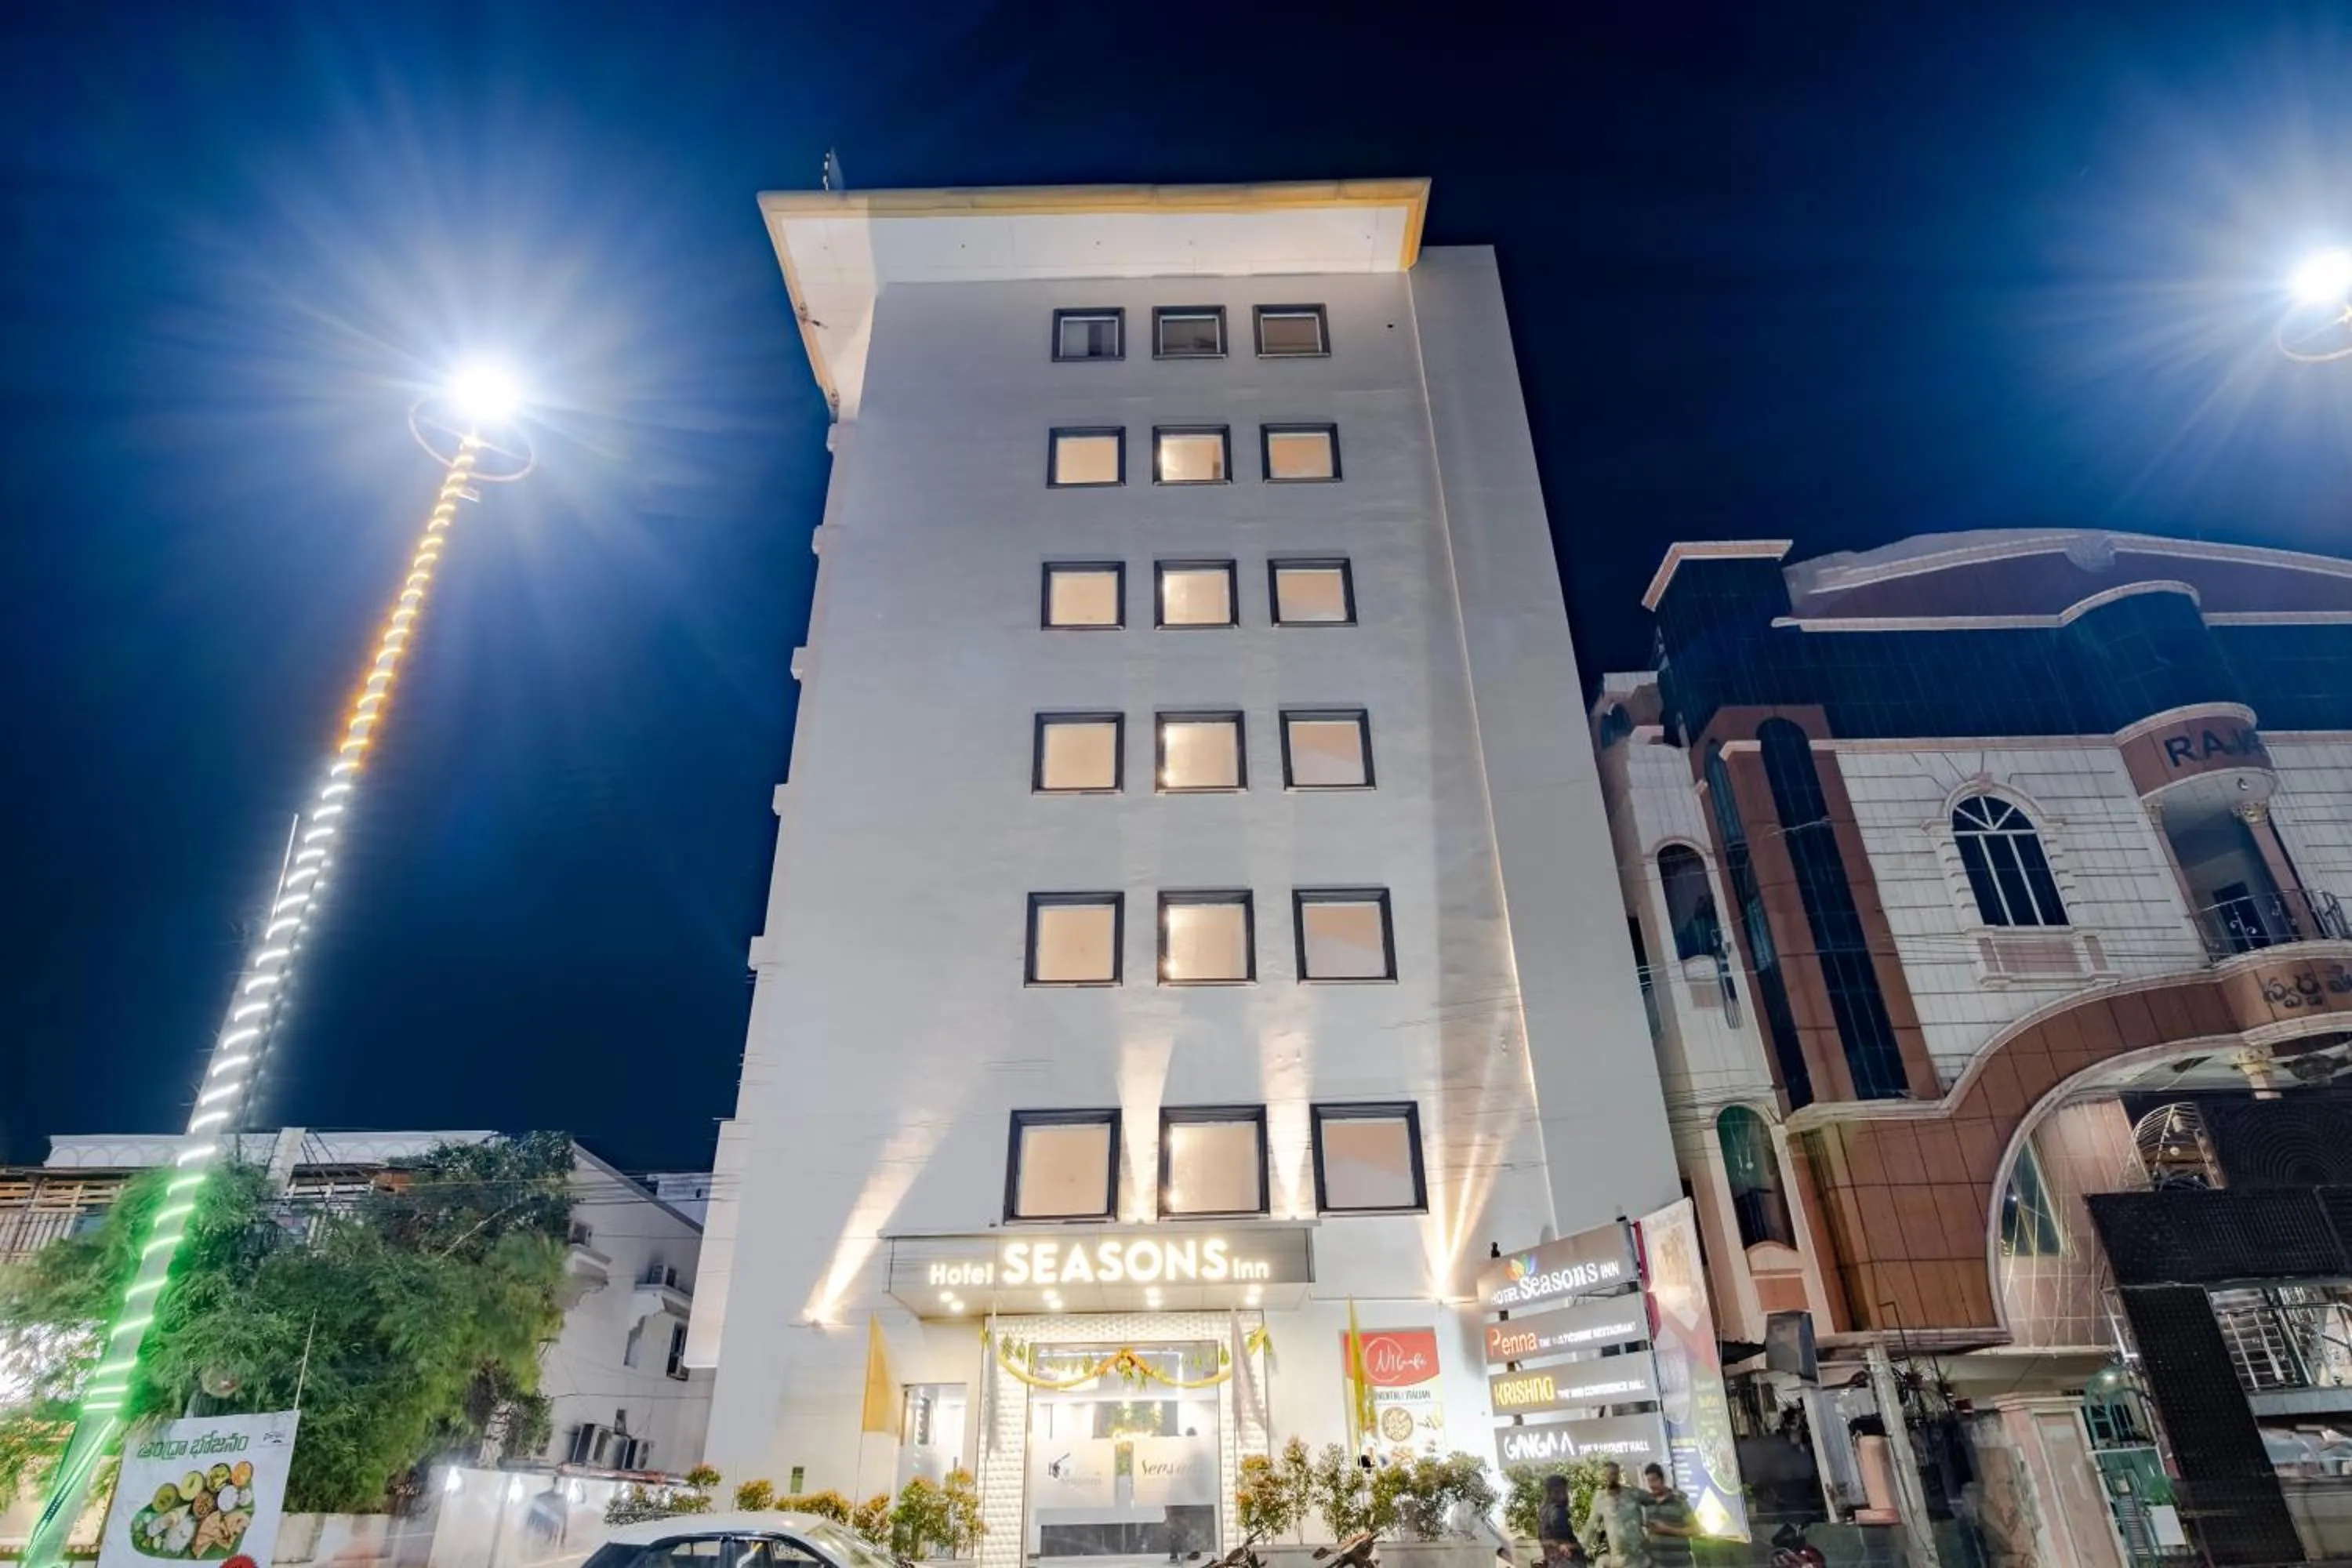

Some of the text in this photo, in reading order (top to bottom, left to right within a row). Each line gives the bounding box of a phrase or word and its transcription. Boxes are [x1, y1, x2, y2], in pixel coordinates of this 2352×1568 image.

[929, 1238, 1270, 1286] Hotel SEASONS Inn
[1519, 1262, 1599, 1300] Seasons
[1489, 1328, 1538, 1357] Penna
